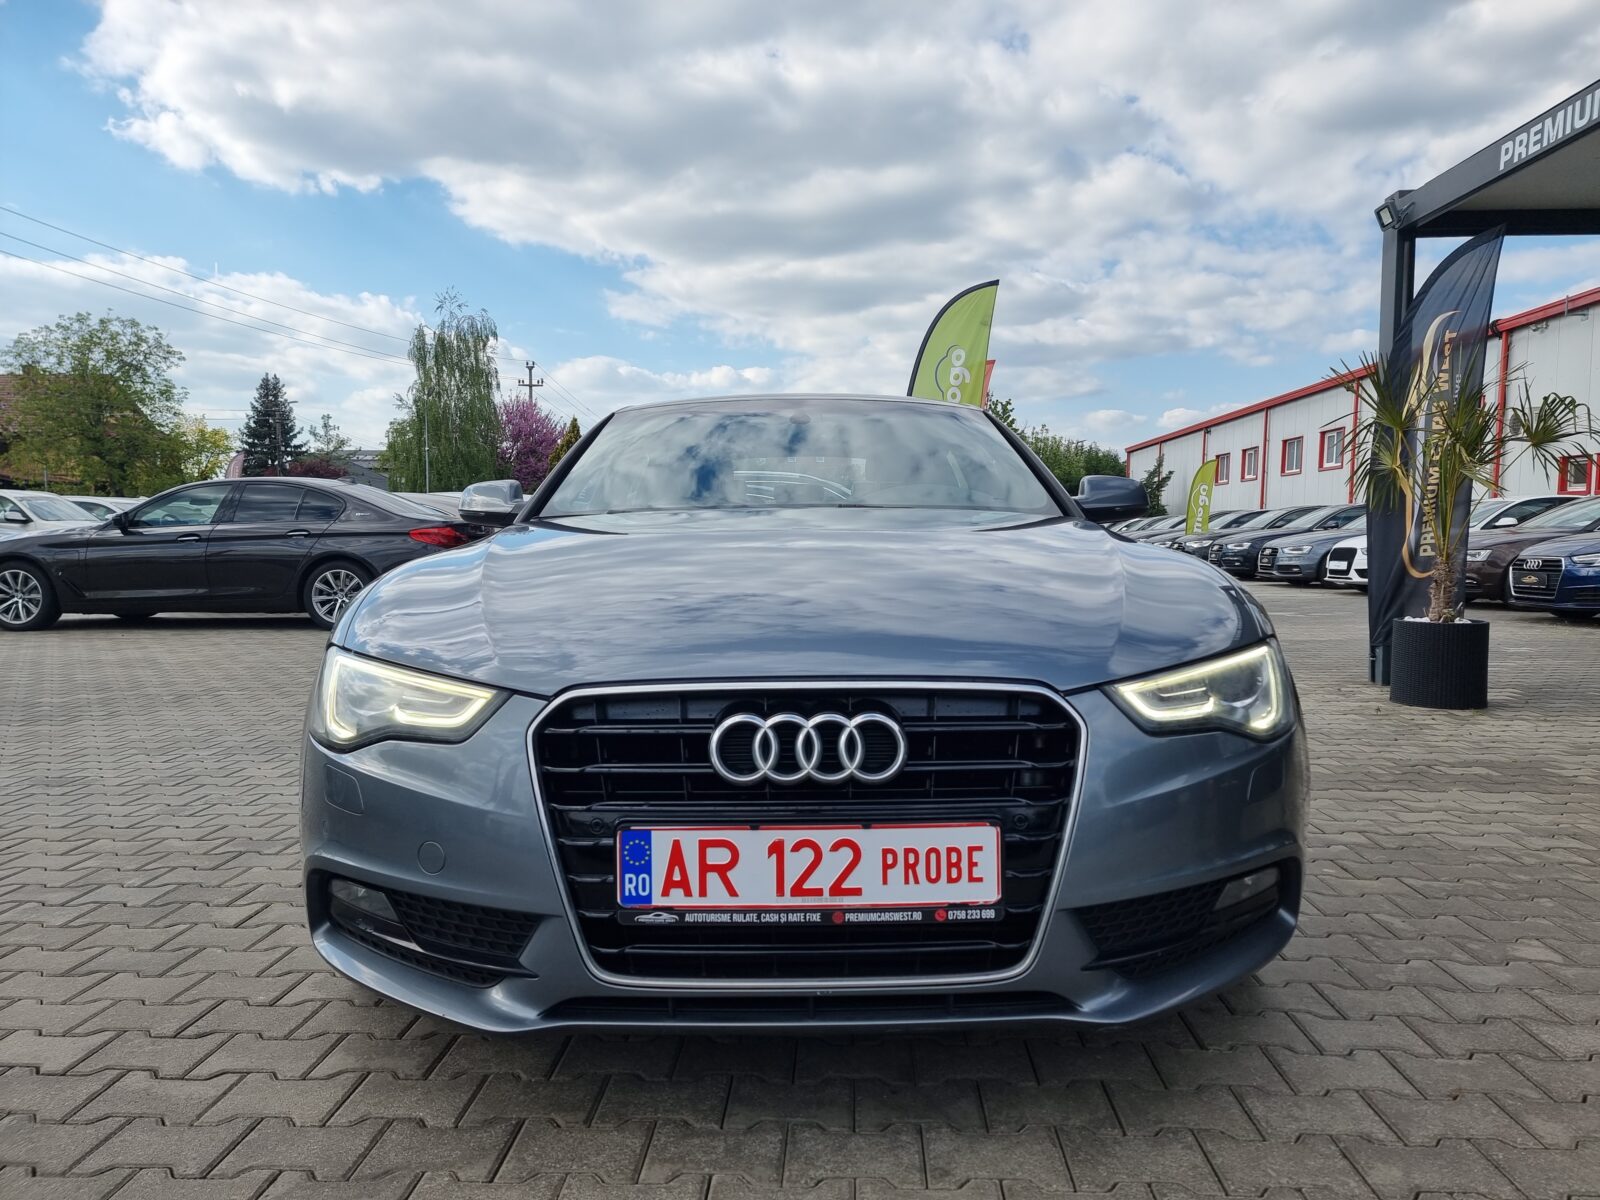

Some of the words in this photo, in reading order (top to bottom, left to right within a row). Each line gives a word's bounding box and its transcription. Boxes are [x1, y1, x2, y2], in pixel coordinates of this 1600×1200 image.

[946, 348, 971, 403] ogo
[1193, 484, 1209, 534] mogo
[1419, 463, 1442, 557] PREMIUM
[624, 873, 650, 897] RO
[660, 838, 741, 898] AR
[767, 837, 863, 898] 122
[881, 845, 984, 886] PROBE
[684, 912, 731, 923] AUTOTURISME
[732, 912, 760, 924] RULATE,
[761, 912, 779, 923] CASH
[788, 912, 805, 922] RATE
[805, 912, 821, 922] FIXE
[845, 911, 922, 922] PREMIUMCARSWEST.RO
[967, 909, 980, 920] 233
